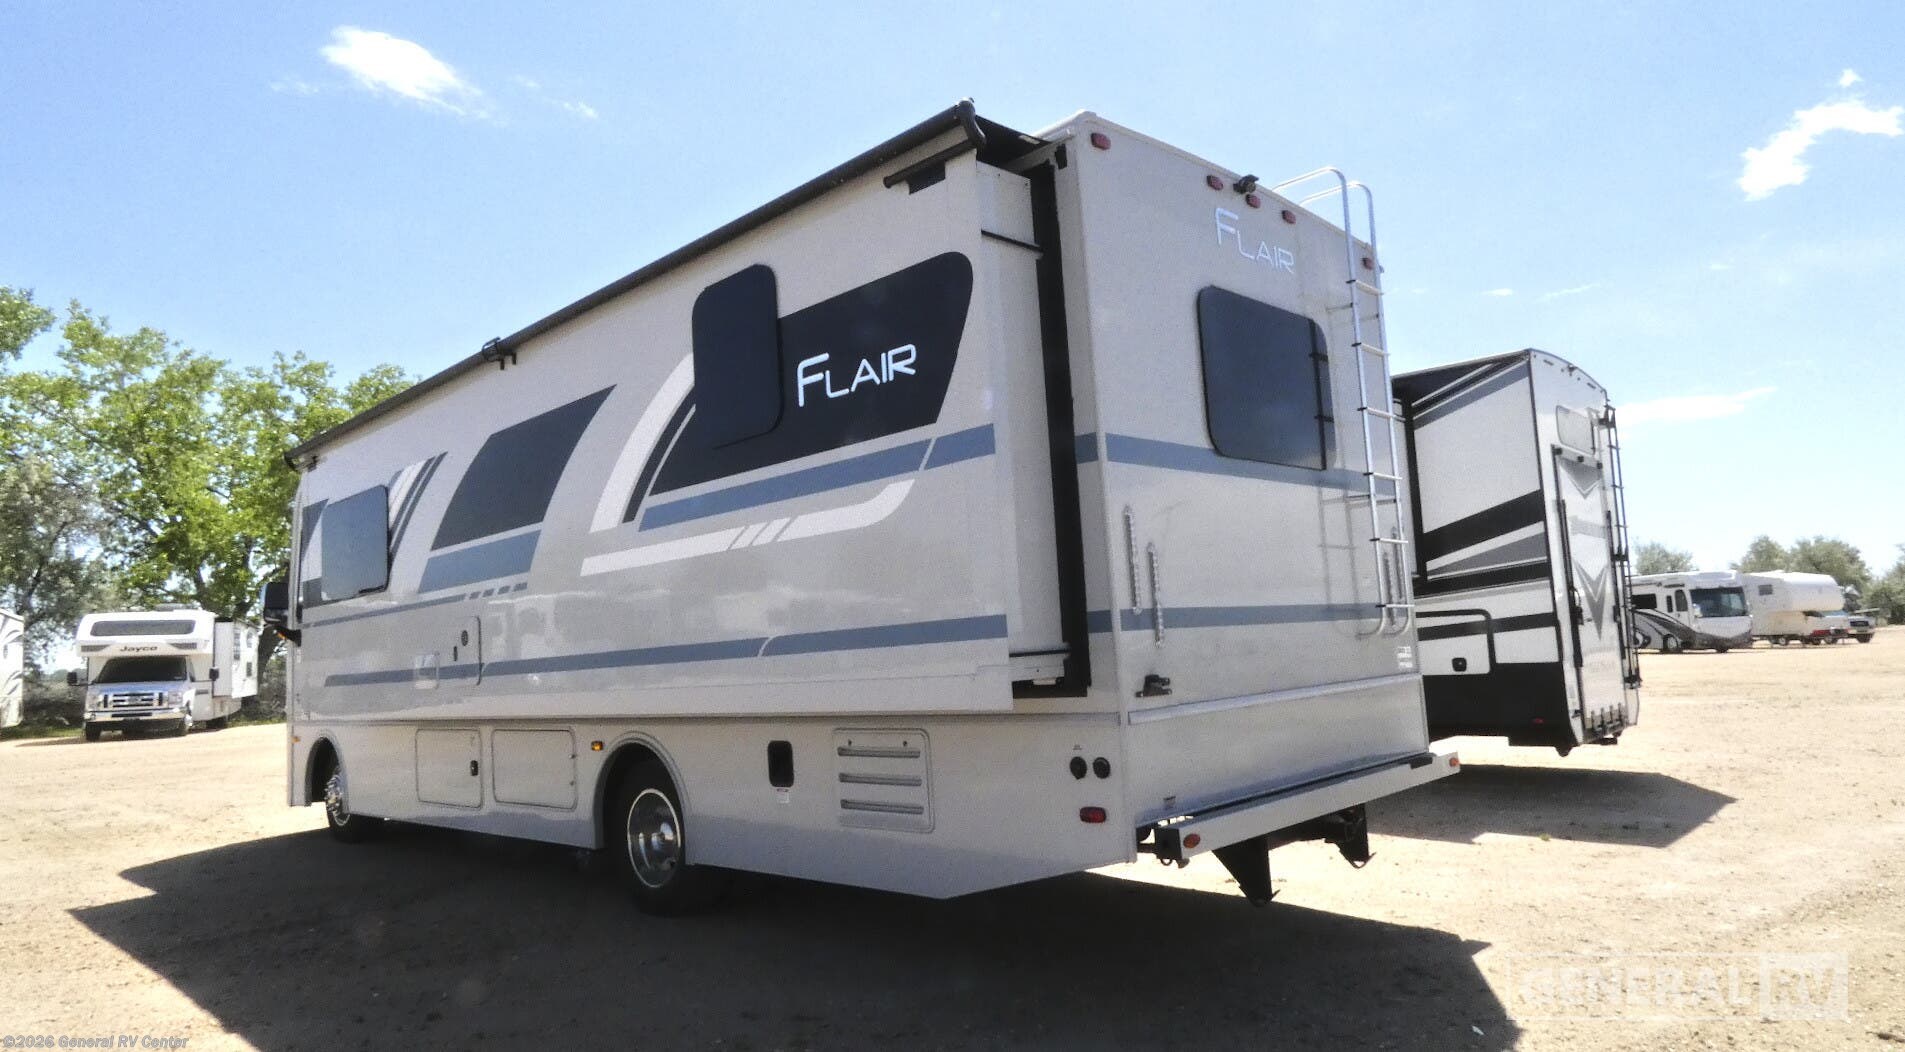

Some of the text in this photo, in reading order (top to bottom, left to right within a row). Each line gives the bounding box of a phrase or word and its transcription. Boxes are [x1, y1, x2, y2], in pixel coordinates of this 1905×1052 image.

[1215, 207, 1294, 274] FLAIR
[797, 343, 917, 408] FLAIR
[120, 645, 158, 653] Jayco
